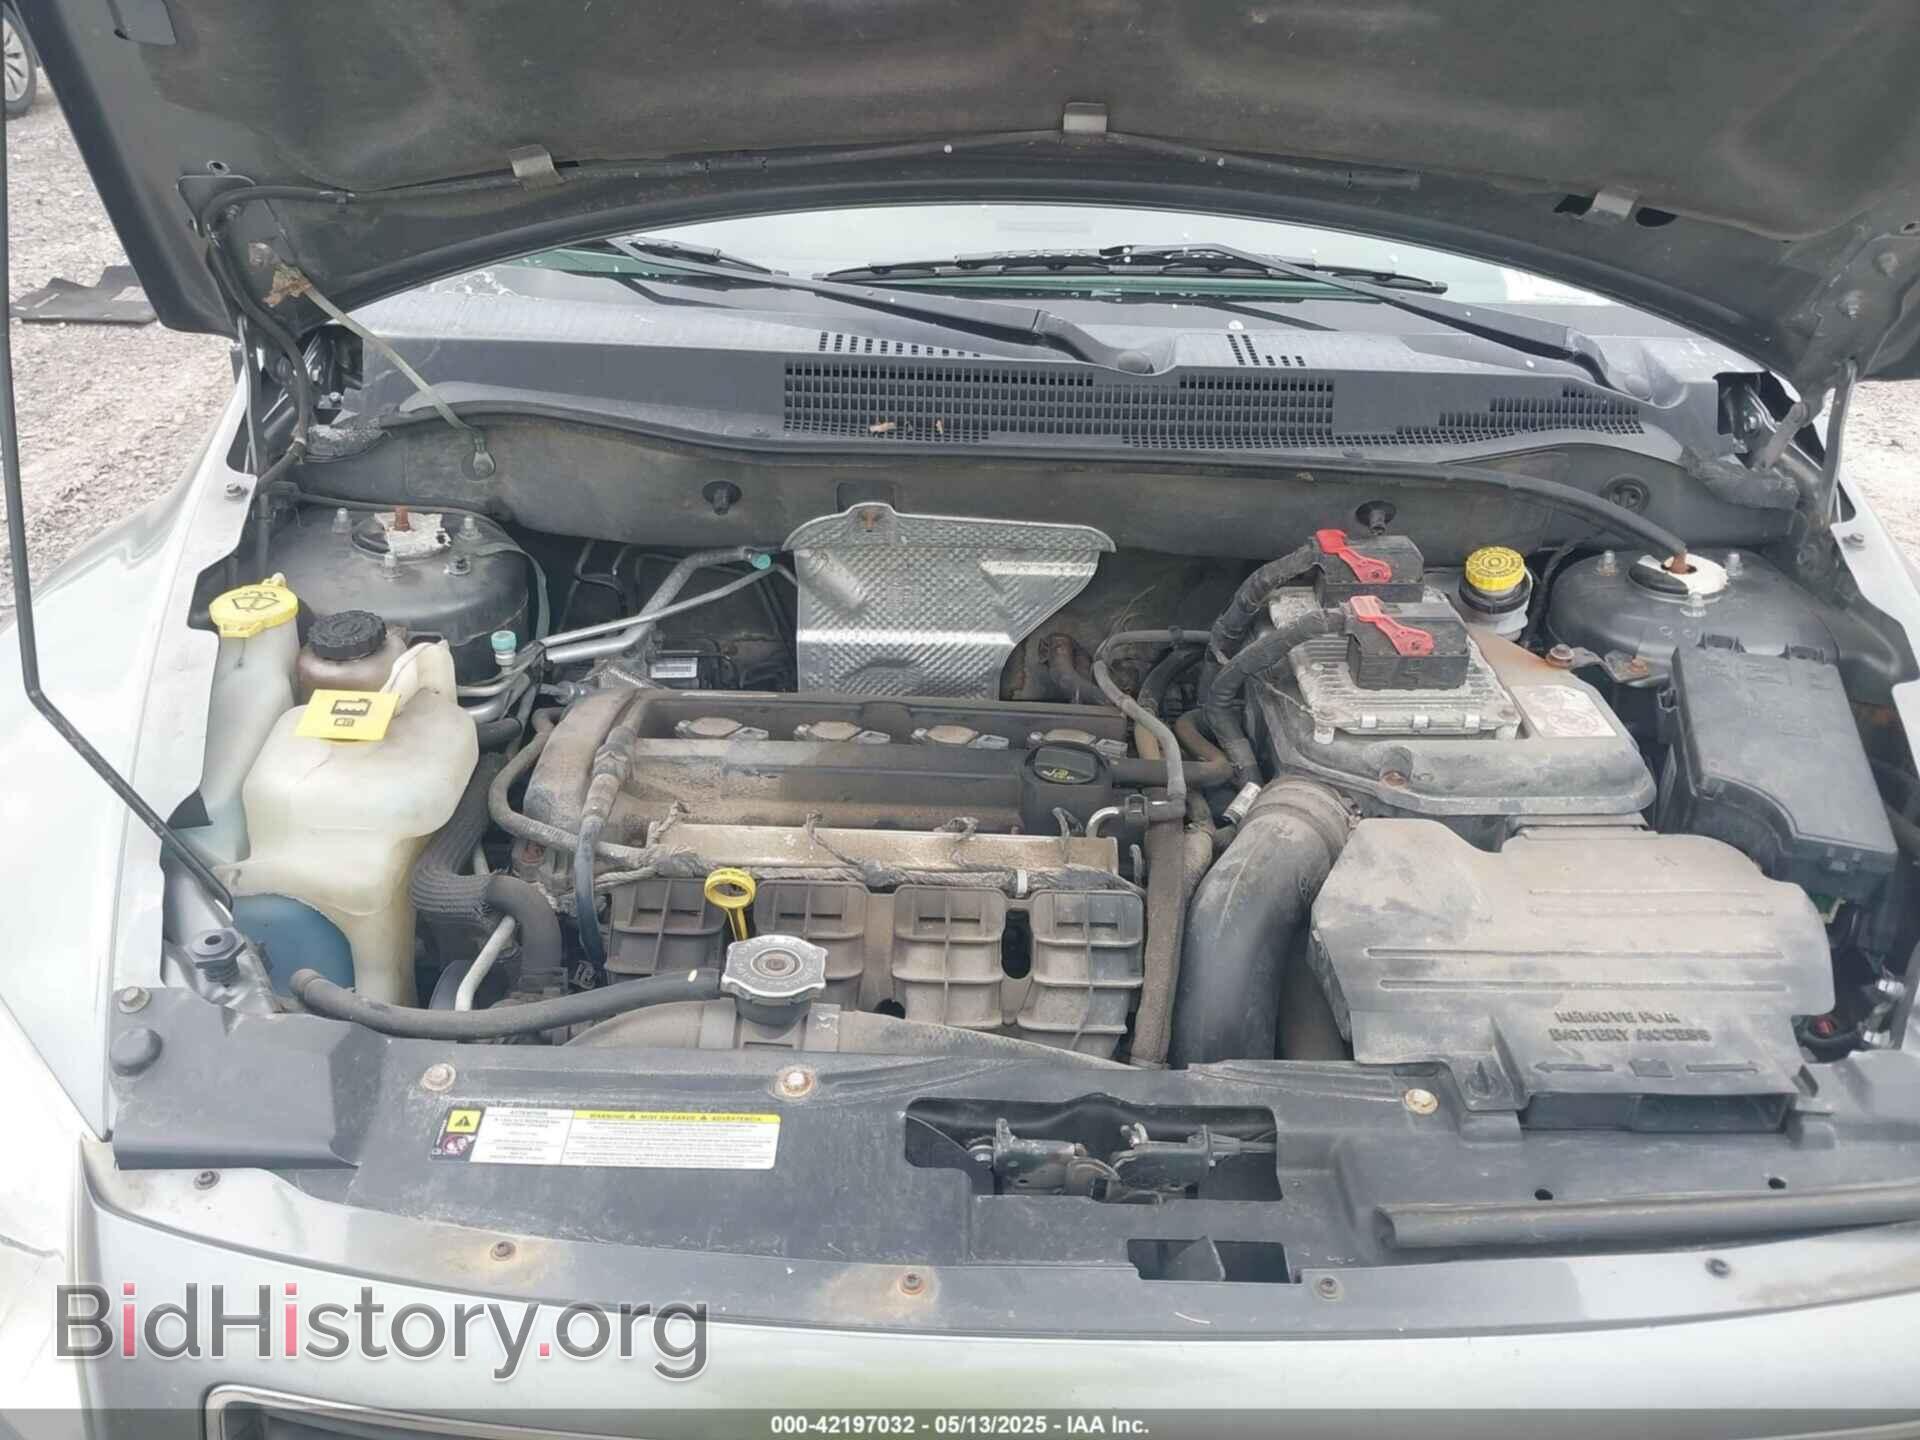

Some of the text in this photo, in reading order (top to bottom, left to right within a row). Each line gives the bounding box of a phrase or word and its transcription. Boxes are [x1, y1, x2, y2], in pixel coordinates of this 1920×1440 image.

[1554, 1011, 1636, 1024] REMOVE
[1549, 1028, 1712, 1042] BATTERY ACCESS
